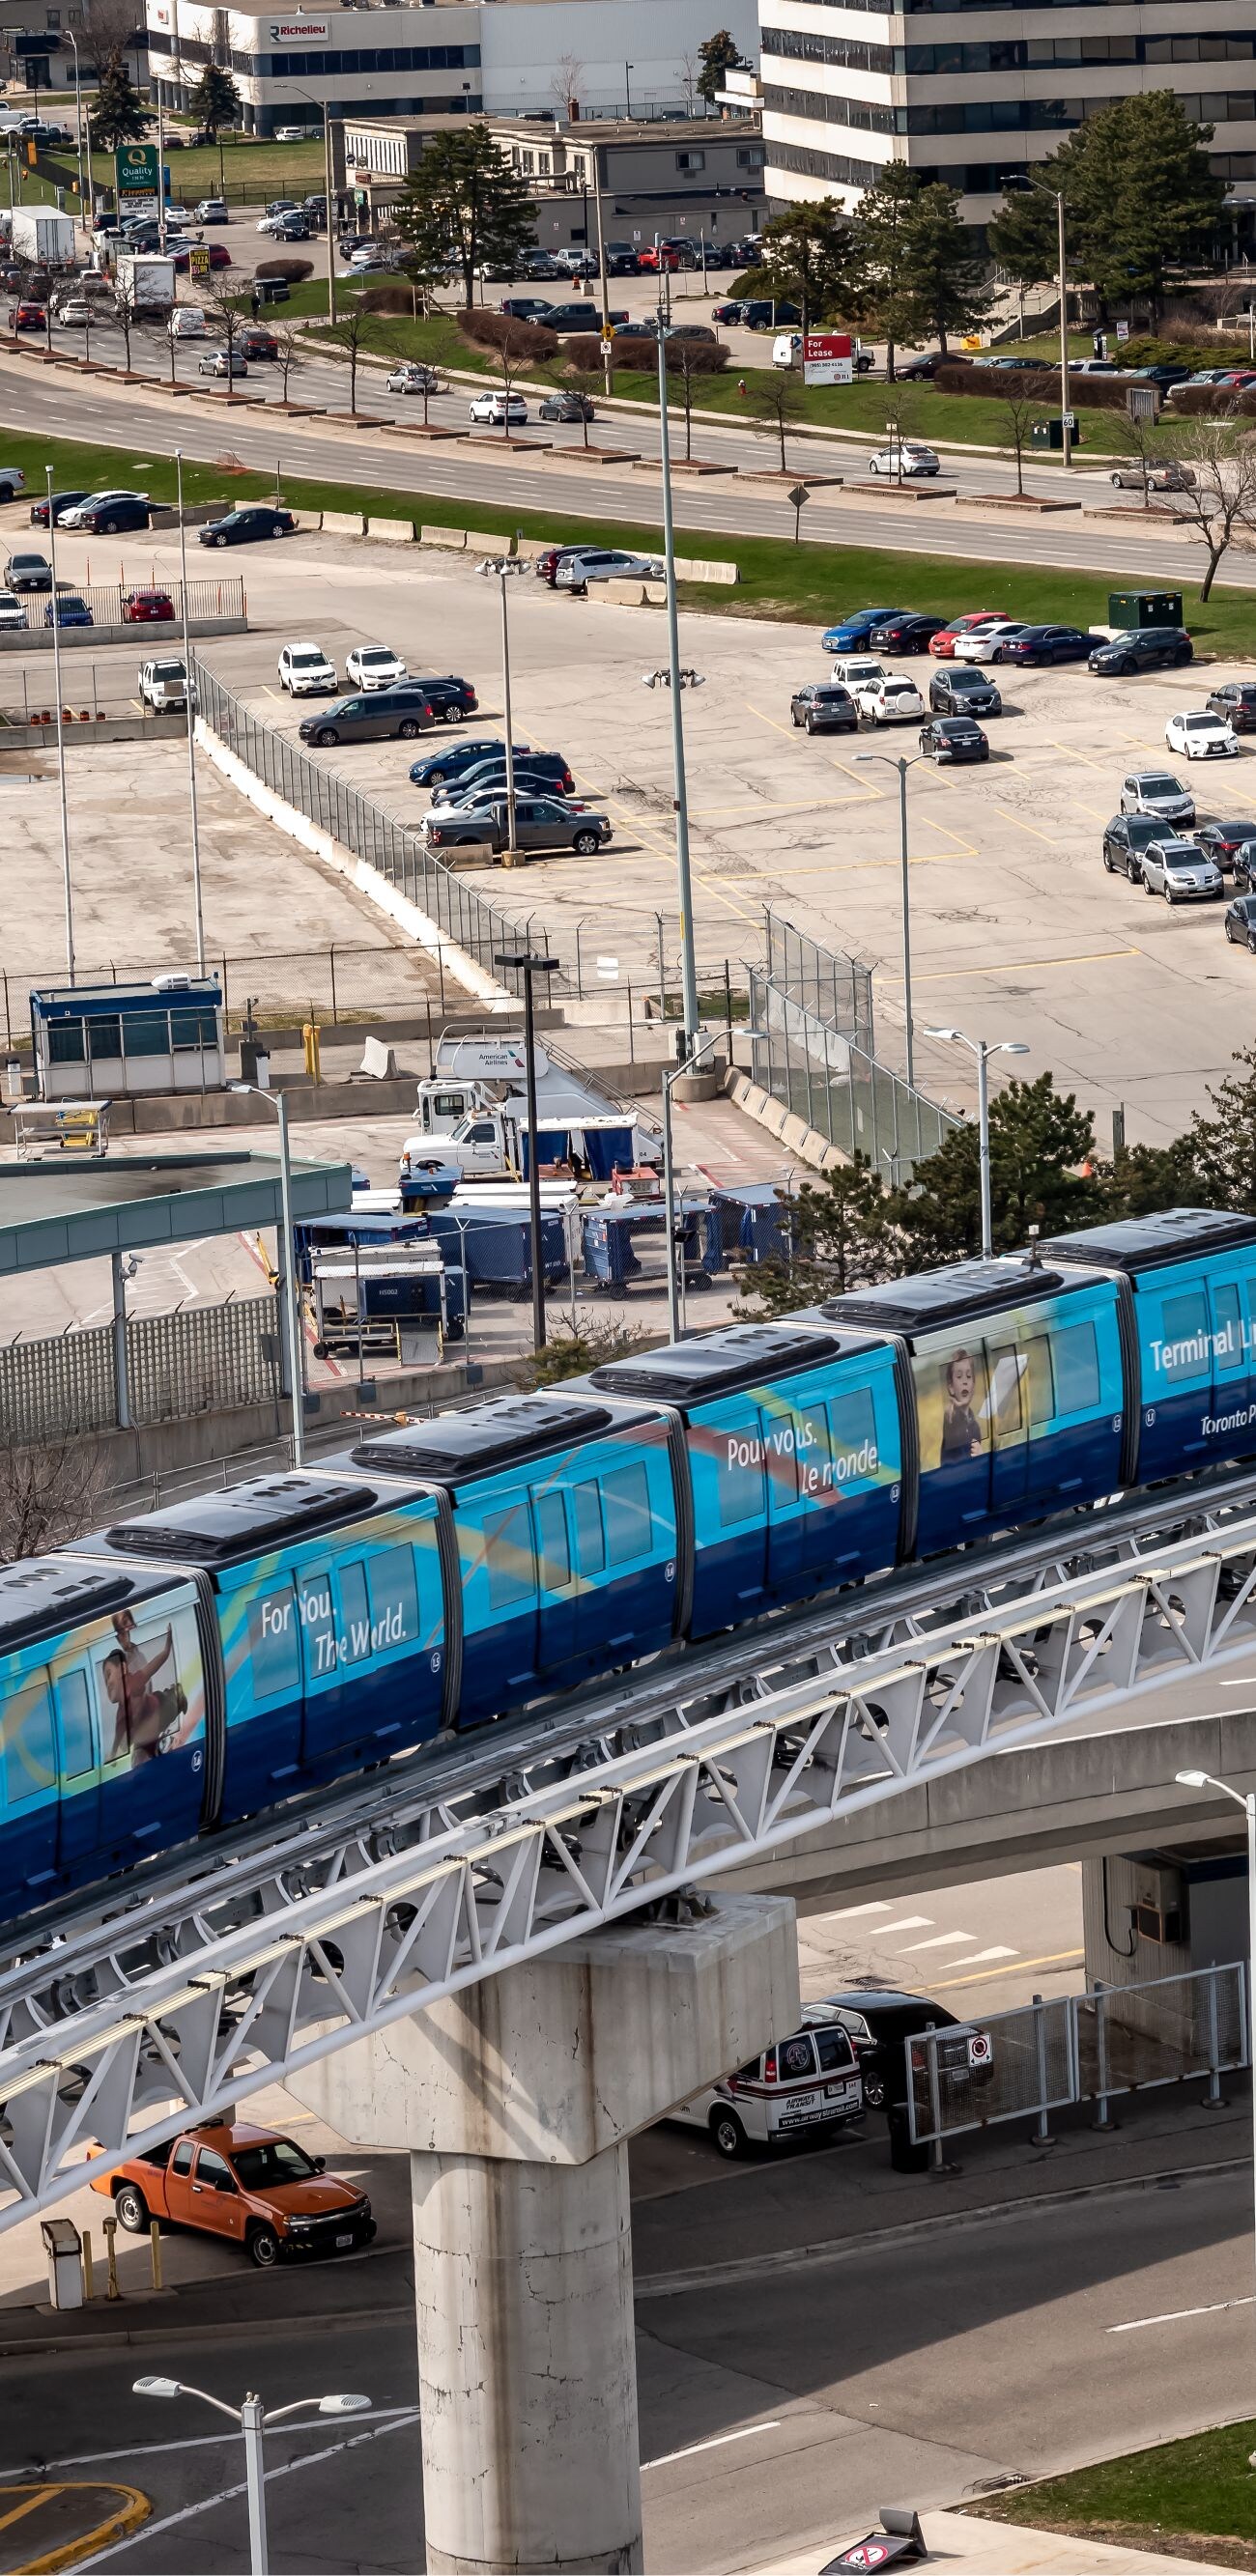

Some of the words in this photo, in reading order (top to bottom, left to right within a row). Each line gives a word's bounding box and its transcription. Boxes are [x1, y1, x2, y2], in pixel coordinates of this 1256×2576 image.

[280, 25, 326, 36] Richelieu
[122, 167, 153, 177] Quality
[191, 255, 209, 266] PIZZA
[1063, 418, 1073, 427] 60
[1150, 1319, 1235, 1372] Terminal
[1201, 1409, 1247, 1436] Toronto
[1248, 1404, 1256, 1424] P
[728, 1435, 771, 1471] Pour
[773, 1422, 817, 1456] vous.
[802, 1462, 818, 1494] Le
[261, 1601, 292, 1638] For
[294, 1590, 337, 1626] You.
[315, 1630, 348, 1670] The
[350, 1602, 407, 1656] World.
[786, 2093, 815, 2104] AIRWAYS
[786, 2099, 816, 2110] TRANSIT
[782, 2101, 859, 2126] www.airwaystransit.com
